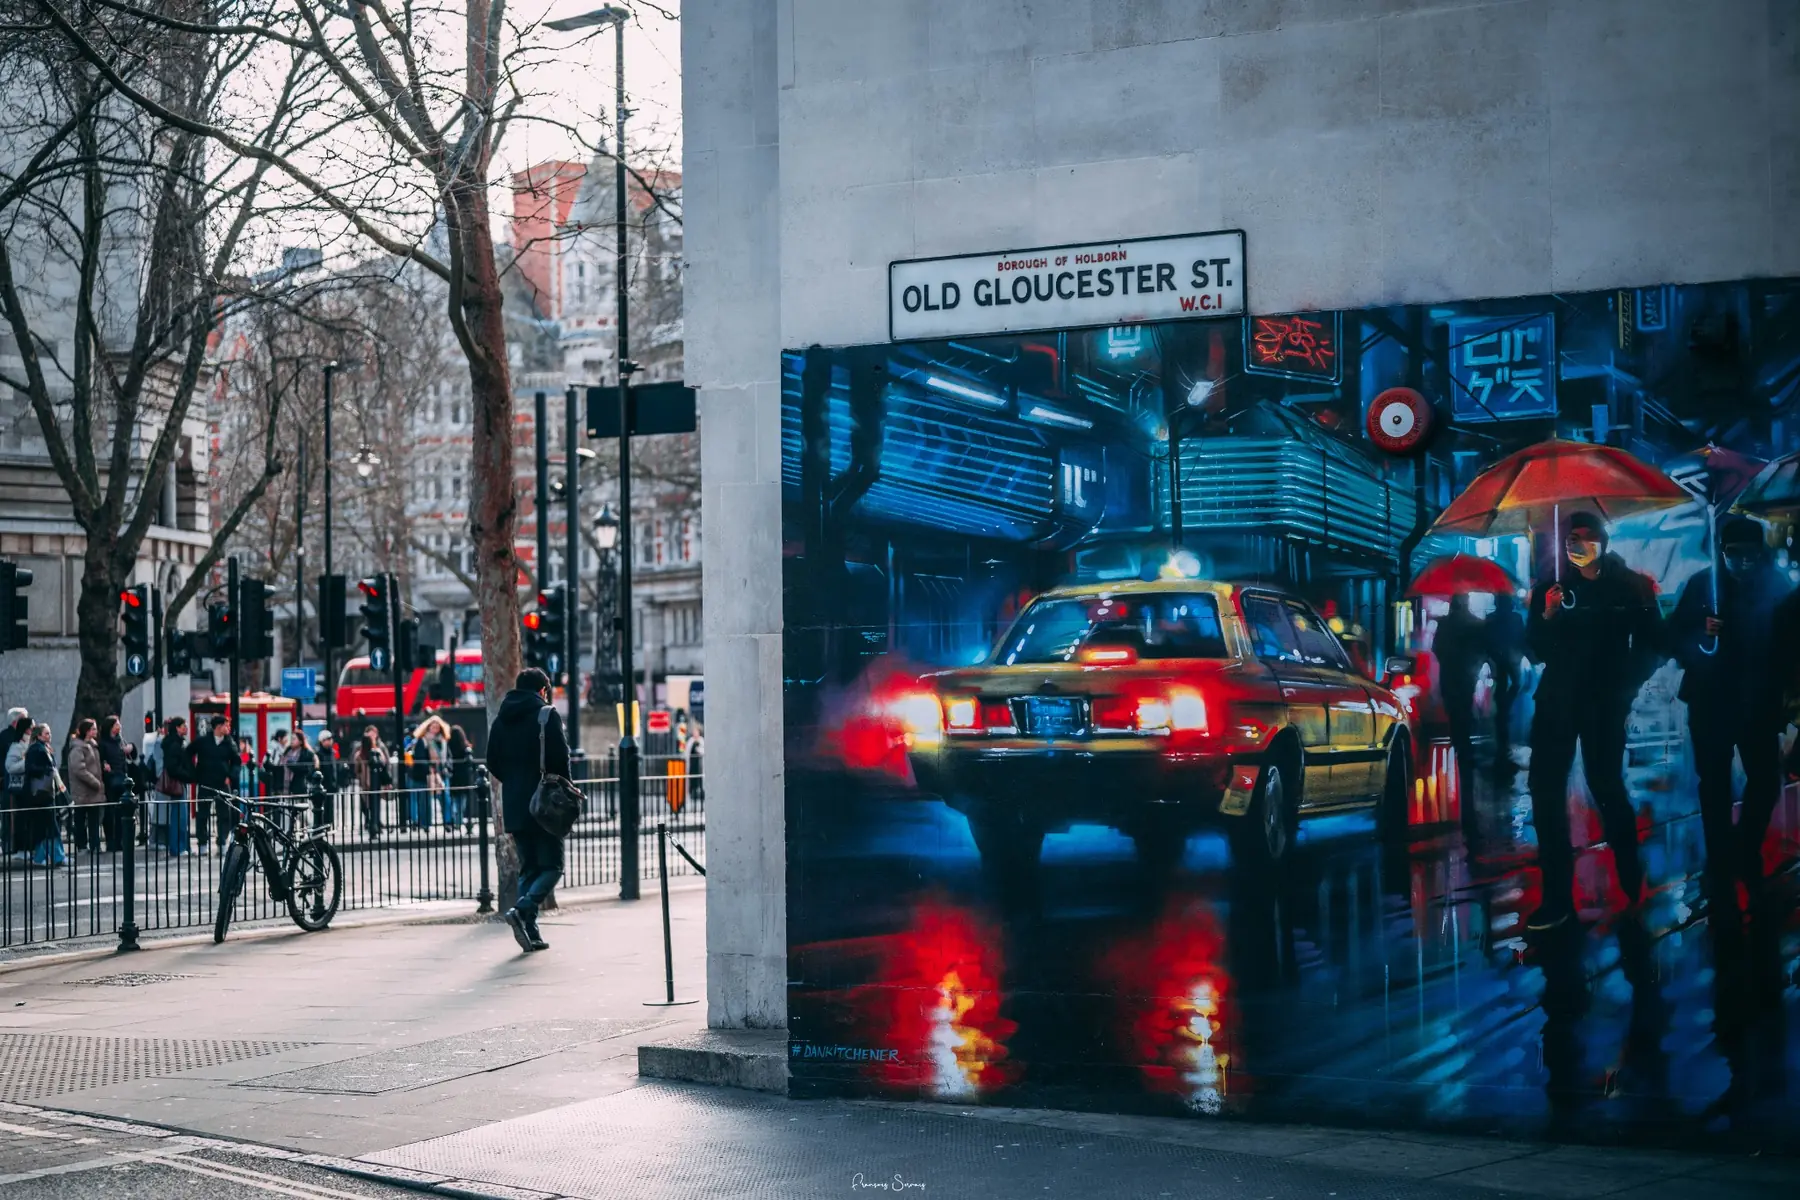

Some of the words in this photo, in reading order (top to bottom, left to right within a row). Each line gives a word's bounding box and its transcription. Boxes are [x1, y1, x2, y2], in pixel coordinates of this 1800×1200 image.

[997, 258, 1048, 272] BOROUGH
[1055, 256, 1068, 266] OF
[1075, 250, 1127, 264] HOLBORN
[902, 282, 961, 313] OLD
[973, 262, 1177, 307] GLOUCESTER
[1191, 258, 1233, 289] ST.
